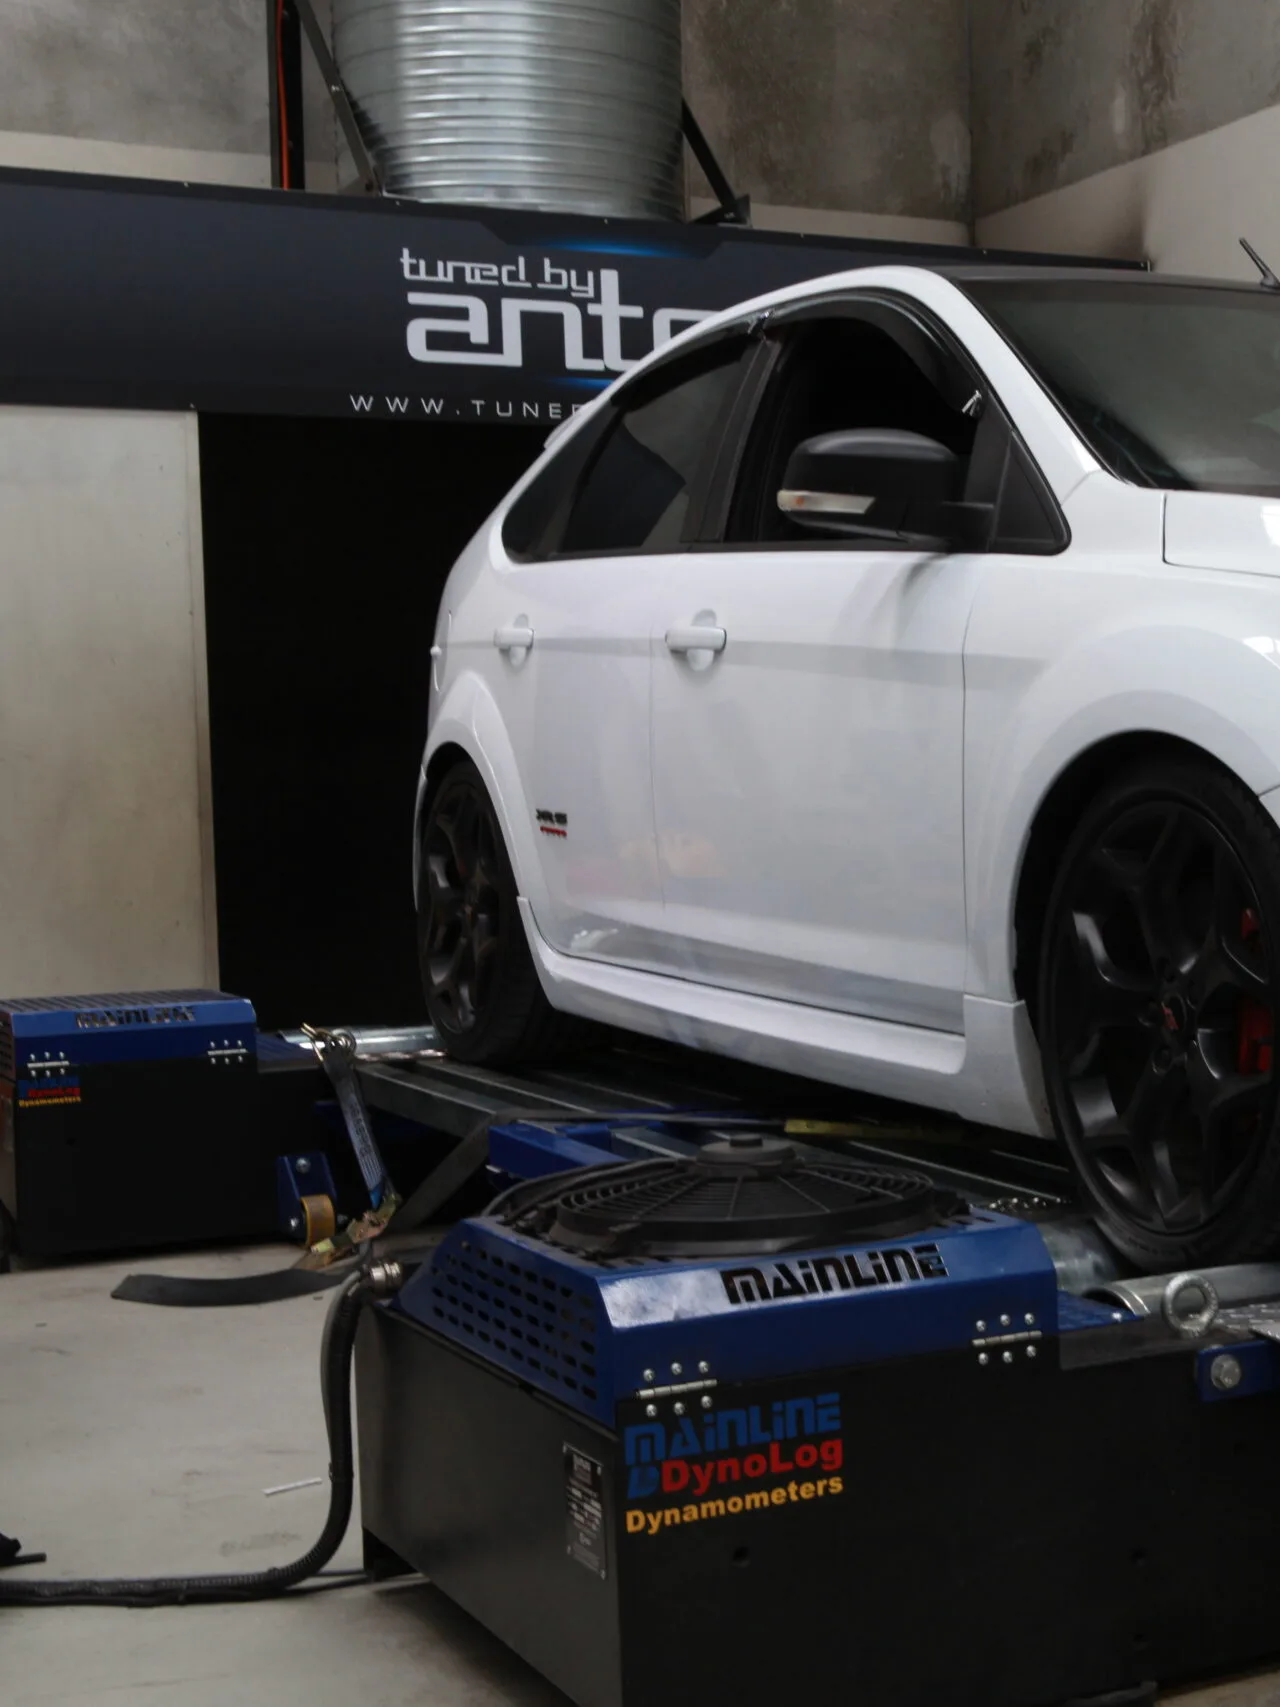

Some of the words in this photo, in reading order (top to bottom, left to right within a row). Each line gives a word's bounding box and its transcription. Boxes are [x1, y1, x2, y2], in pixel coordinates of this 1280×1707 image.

[400, 247, 532, 288] tuned
[537, 257, 595, 298] by
[660, 1438, 844, 1497] DynoLog
[625, 1475, 844, 1535] Dynamometers
